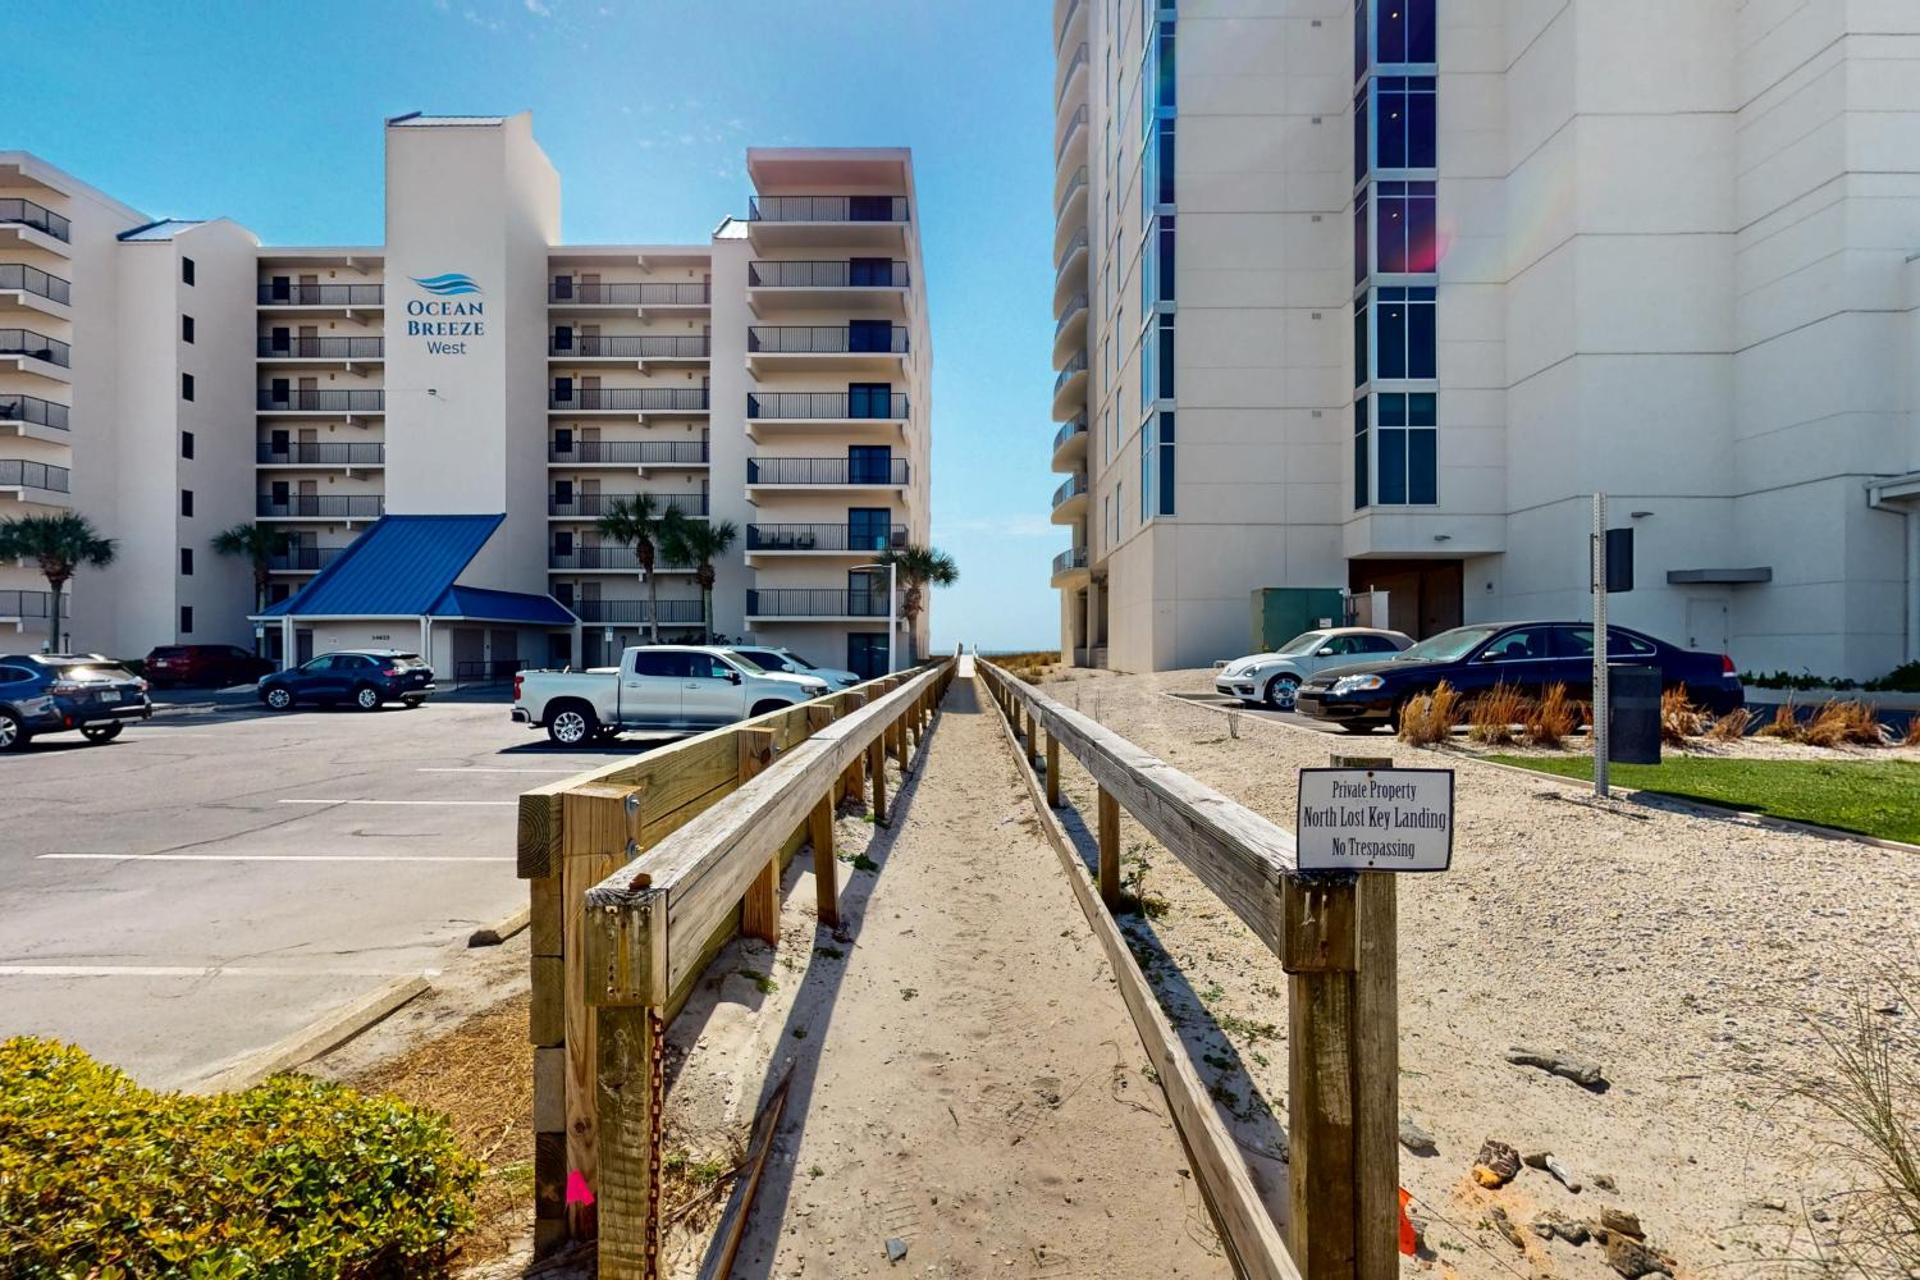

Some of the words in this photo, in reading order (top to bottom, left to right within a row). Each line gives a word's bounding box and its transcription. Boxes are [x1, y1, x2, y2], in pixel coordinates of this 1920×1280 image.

[407, 300, 483, 316] OCEAN
[408, 320, 484, 336] BREEZE
[427, 341, 467, 354] West
[1332, 781, 1367, 799] Private
[1370, 781, 1417, 801] Property
[1303, 806, 1337, 828] North
[1340, 806, 1365, 827] Lost
[1368, 806, 1391, 830] Key
[1394, 806, 1446, 832] Landing
[1332, 838, 1346, 856] No
[1349, 838, 1415, 859] Trespassing
